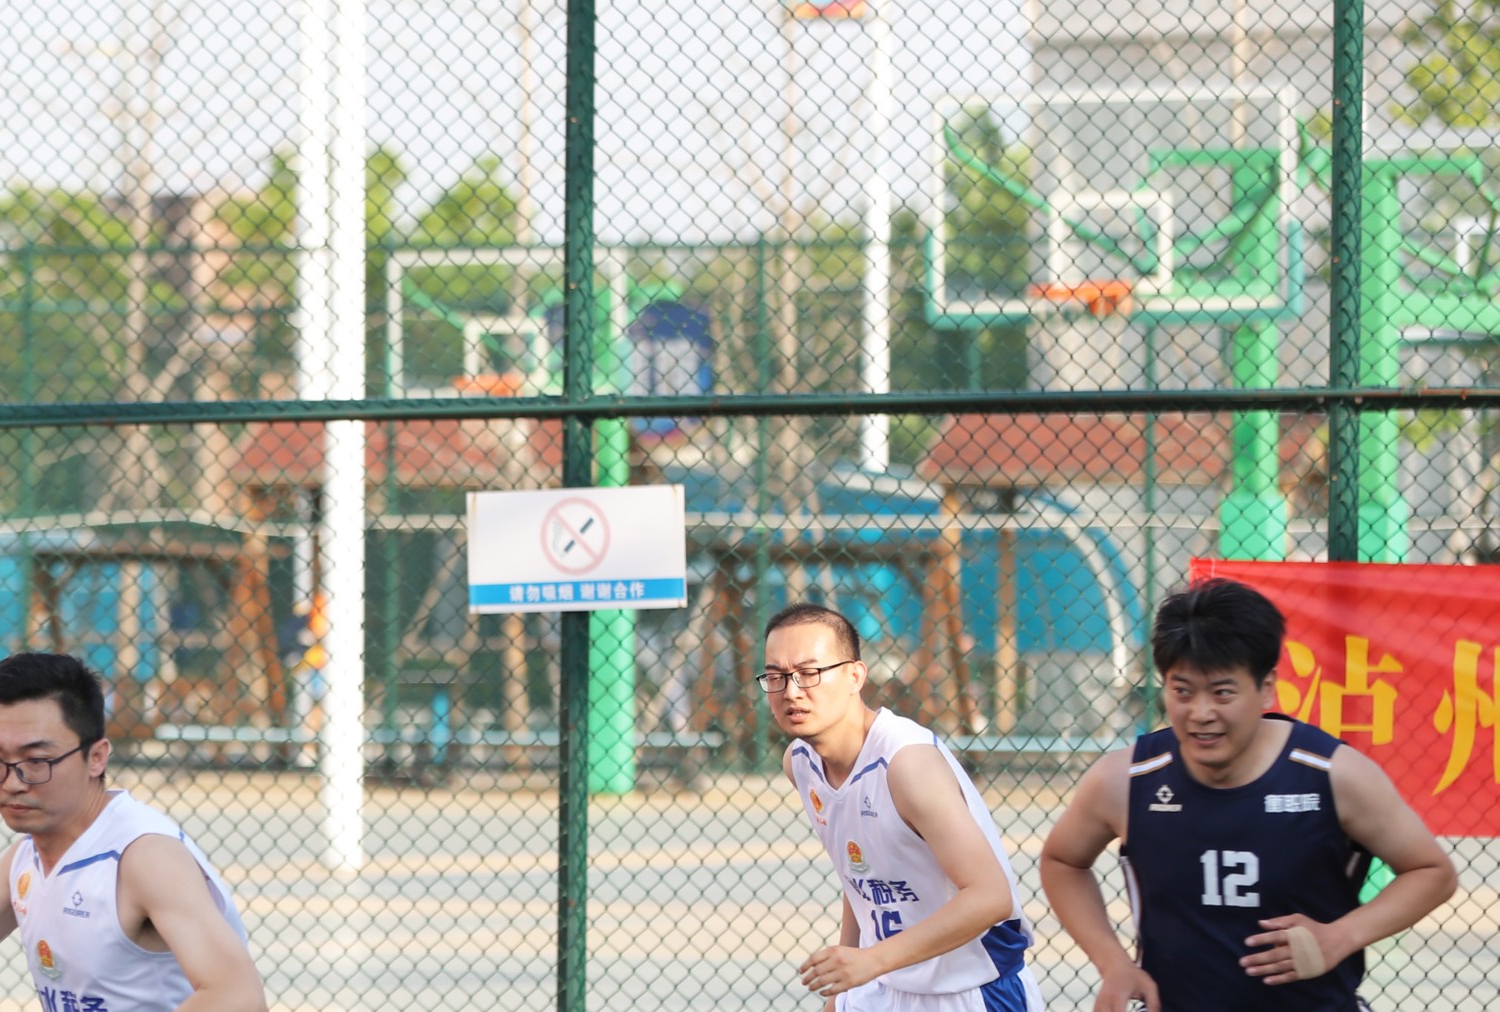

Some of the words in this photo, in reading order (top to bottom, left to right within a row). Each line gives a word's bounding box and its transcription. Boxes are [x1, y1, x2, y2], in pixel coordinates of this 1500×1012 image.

[580, 581, 645, 600] 谢谢合作
[844, 876, 919, 905] 水税务
[1200, 850, 1260, 907] 12
